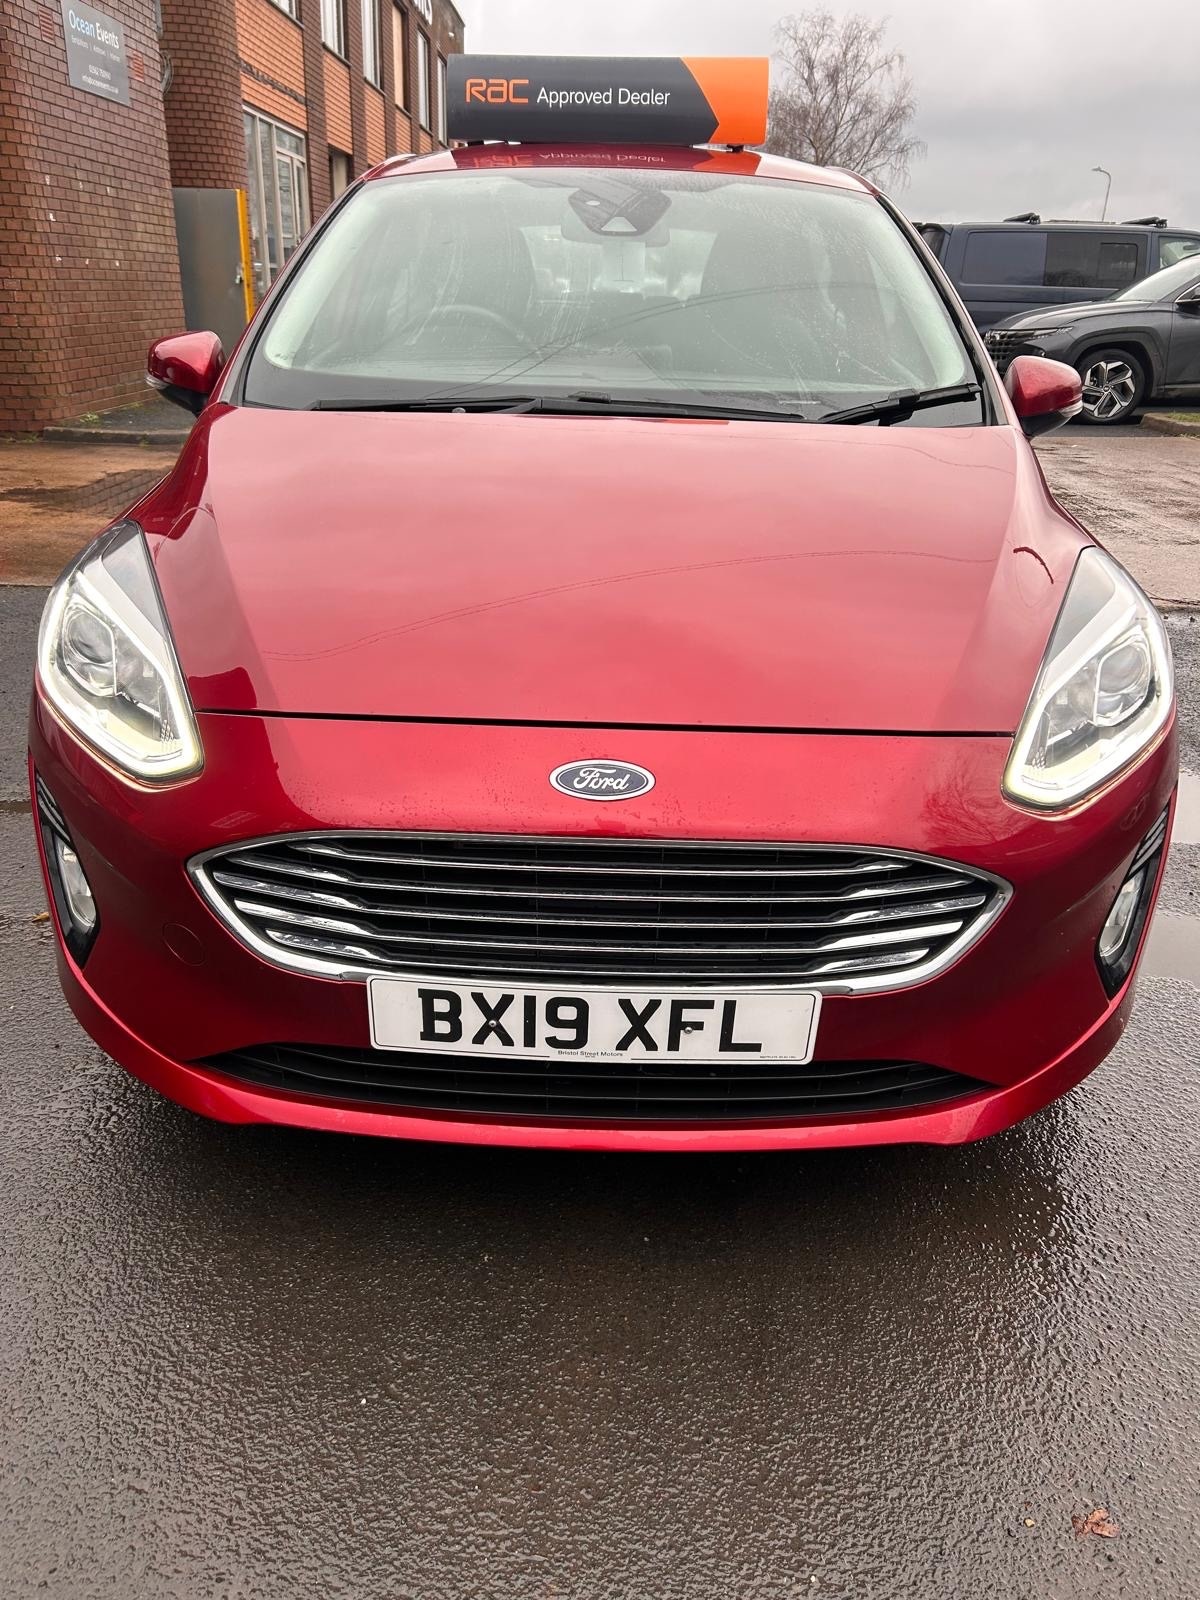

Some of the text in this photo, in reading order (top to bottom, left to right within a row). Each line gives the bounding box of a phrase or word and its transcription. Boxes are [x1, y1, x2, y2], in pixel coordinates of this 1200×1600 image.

[68, 9, 95, 38] Ocean
[95, 22, 119, 49] Events
[537, 87, 612, 108] Approved
[618, 88, 670, 105] Dealer
[573, 767, 630, 790] Ford
[417, 988, 763, 1053] BX19 XFL
